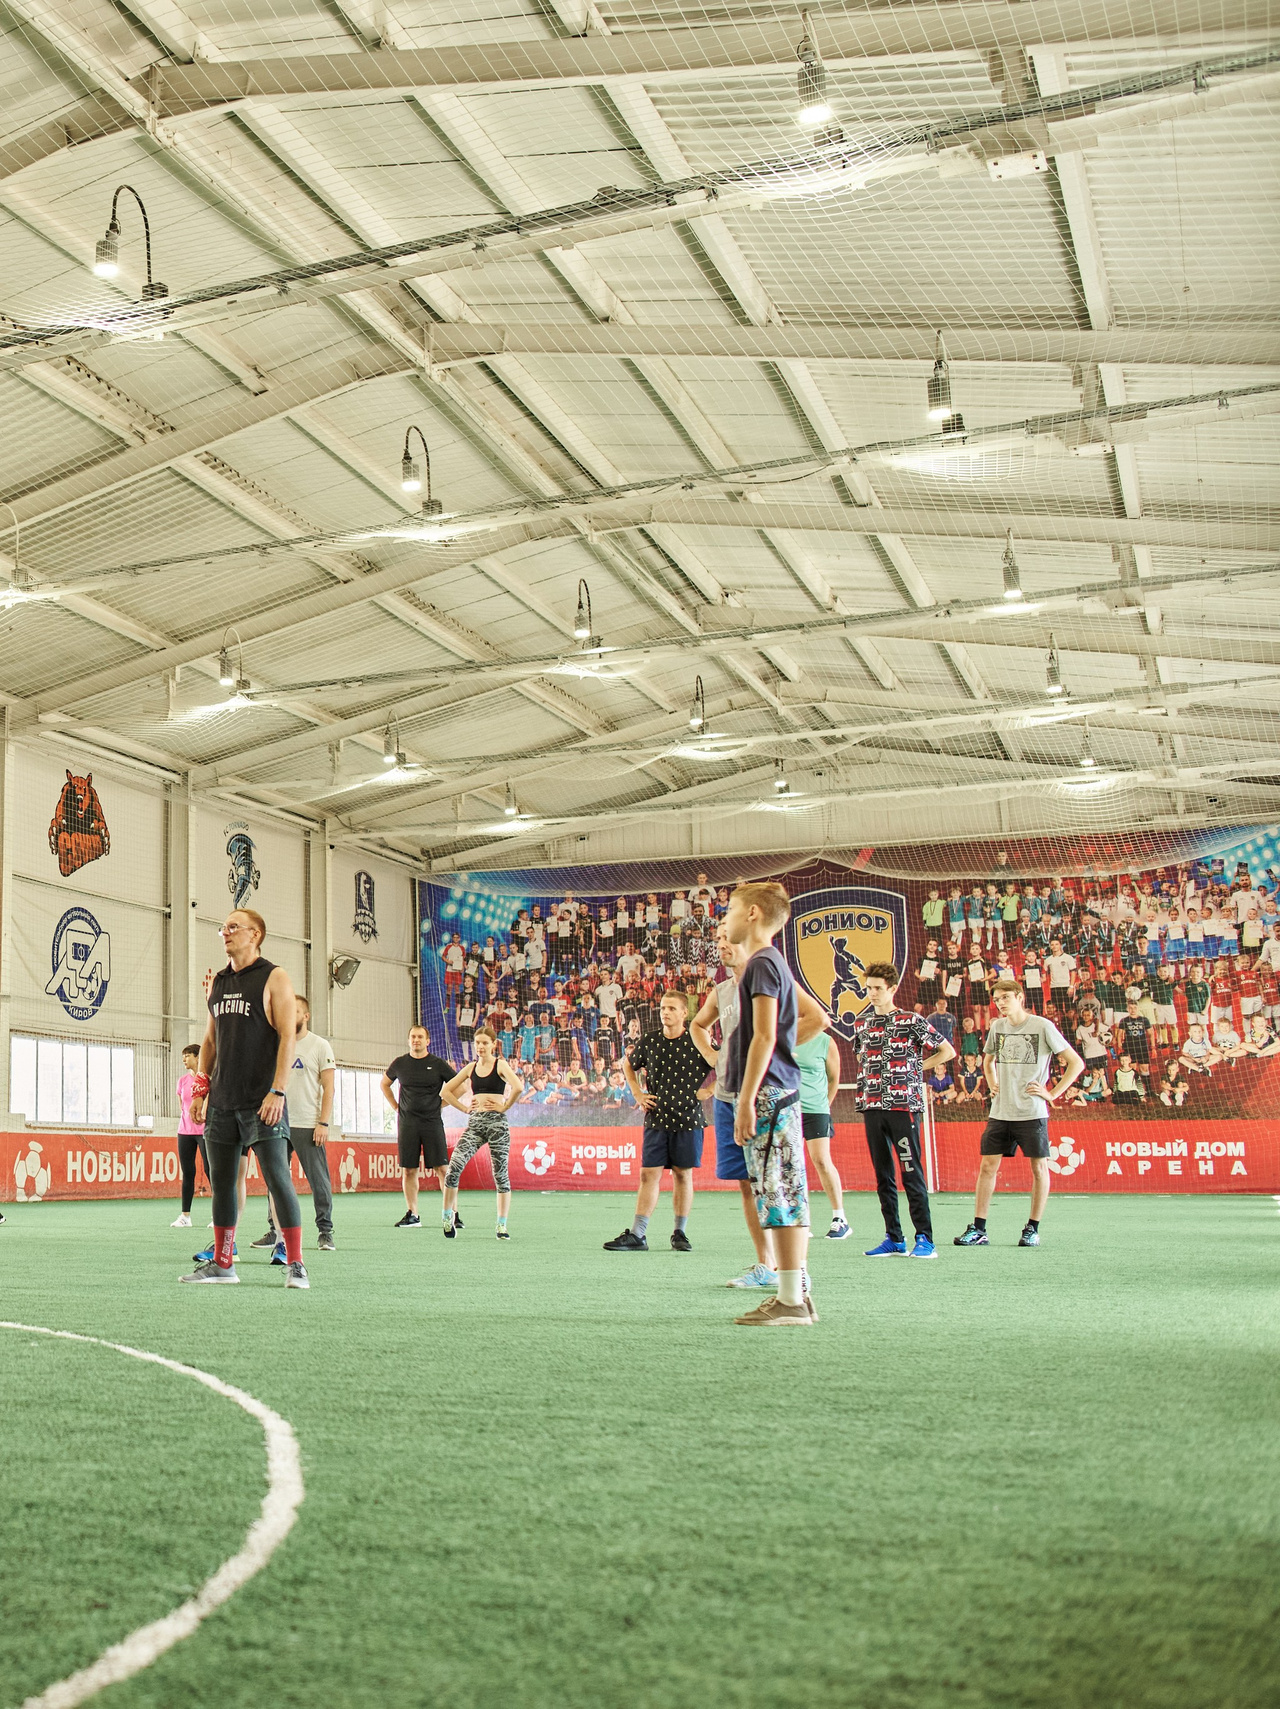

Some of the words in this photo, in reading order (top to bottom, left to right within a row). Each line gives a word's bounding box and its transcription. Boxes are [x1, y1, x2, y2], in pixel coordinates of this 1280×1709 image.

[801, 911, 889, 939] ЮНИОР
[68, 1006, 93, 1018] КИРОВ
[213, 1000, 251, 1017] MACHINE
[571, 1143, 636, 1159] НОВЫЙ
[898, 1136, 914, 1172] FILA
[1106, 1139, 1188, 1157] НОВЫЙ
[1194, 1141, 1246, 1159] ДОМ
[67, 1145, 145, 1183] НОВЫЙ
[571, 1161, 631, 1176] АРЕ
[1106, 1160, 1248, 1176] АРЕНА
